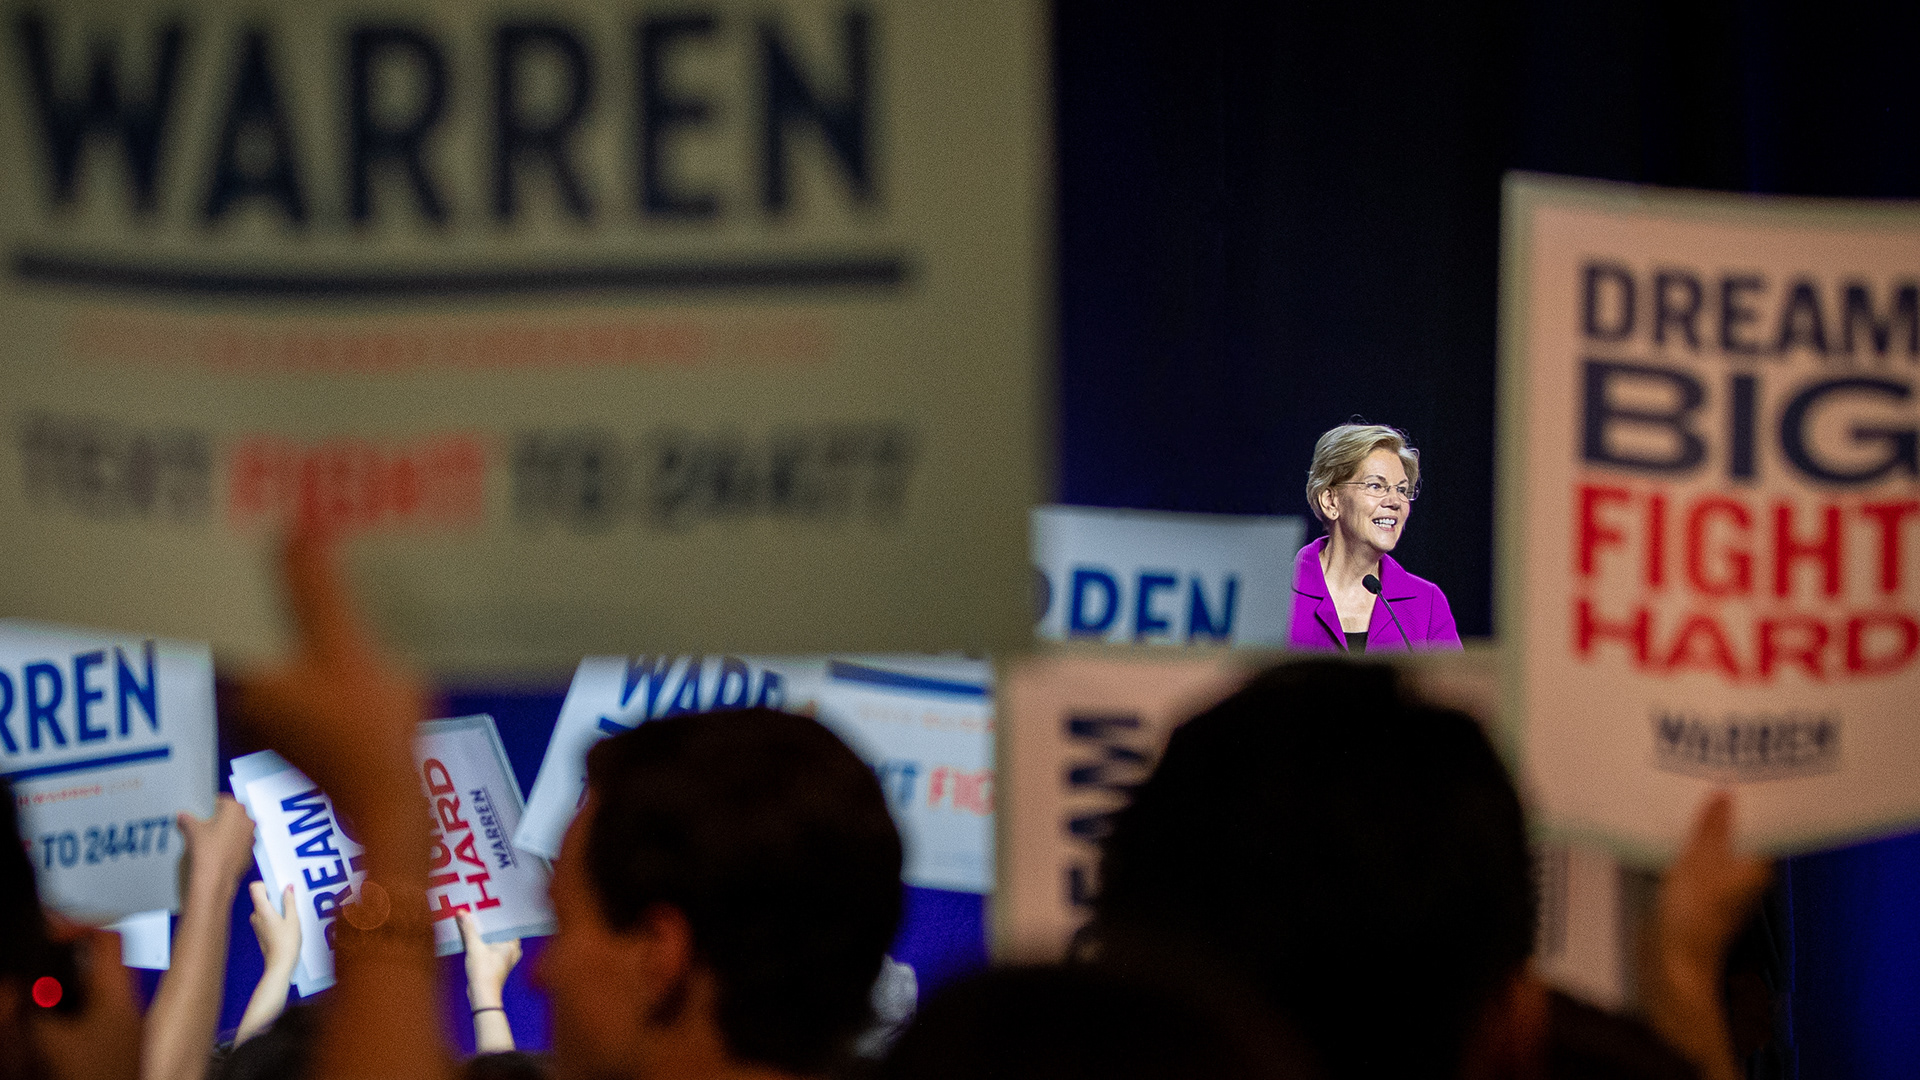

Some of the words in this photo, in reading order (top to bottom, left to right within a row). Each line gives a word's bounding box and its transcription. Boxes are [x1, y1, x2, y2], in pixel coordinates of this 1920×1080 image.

[14, 5, 882, 228] WARREN
[1582, 260, 1920, 356] DREAM
[1582, 359, 1920, 486] BIG
[1577, 483, 1920, 596] FIGHT
[1034, 567, 1239, 642] REN
[1577, 599, 1920, 686] HARD
[40, 830, 79, 869] TO
[84, 817, 172, 864] 24477
[281, 787, 351, 949] REAM
[424, 758, 501, 911] HARD
[470, 786, 512, 870] WARREN
